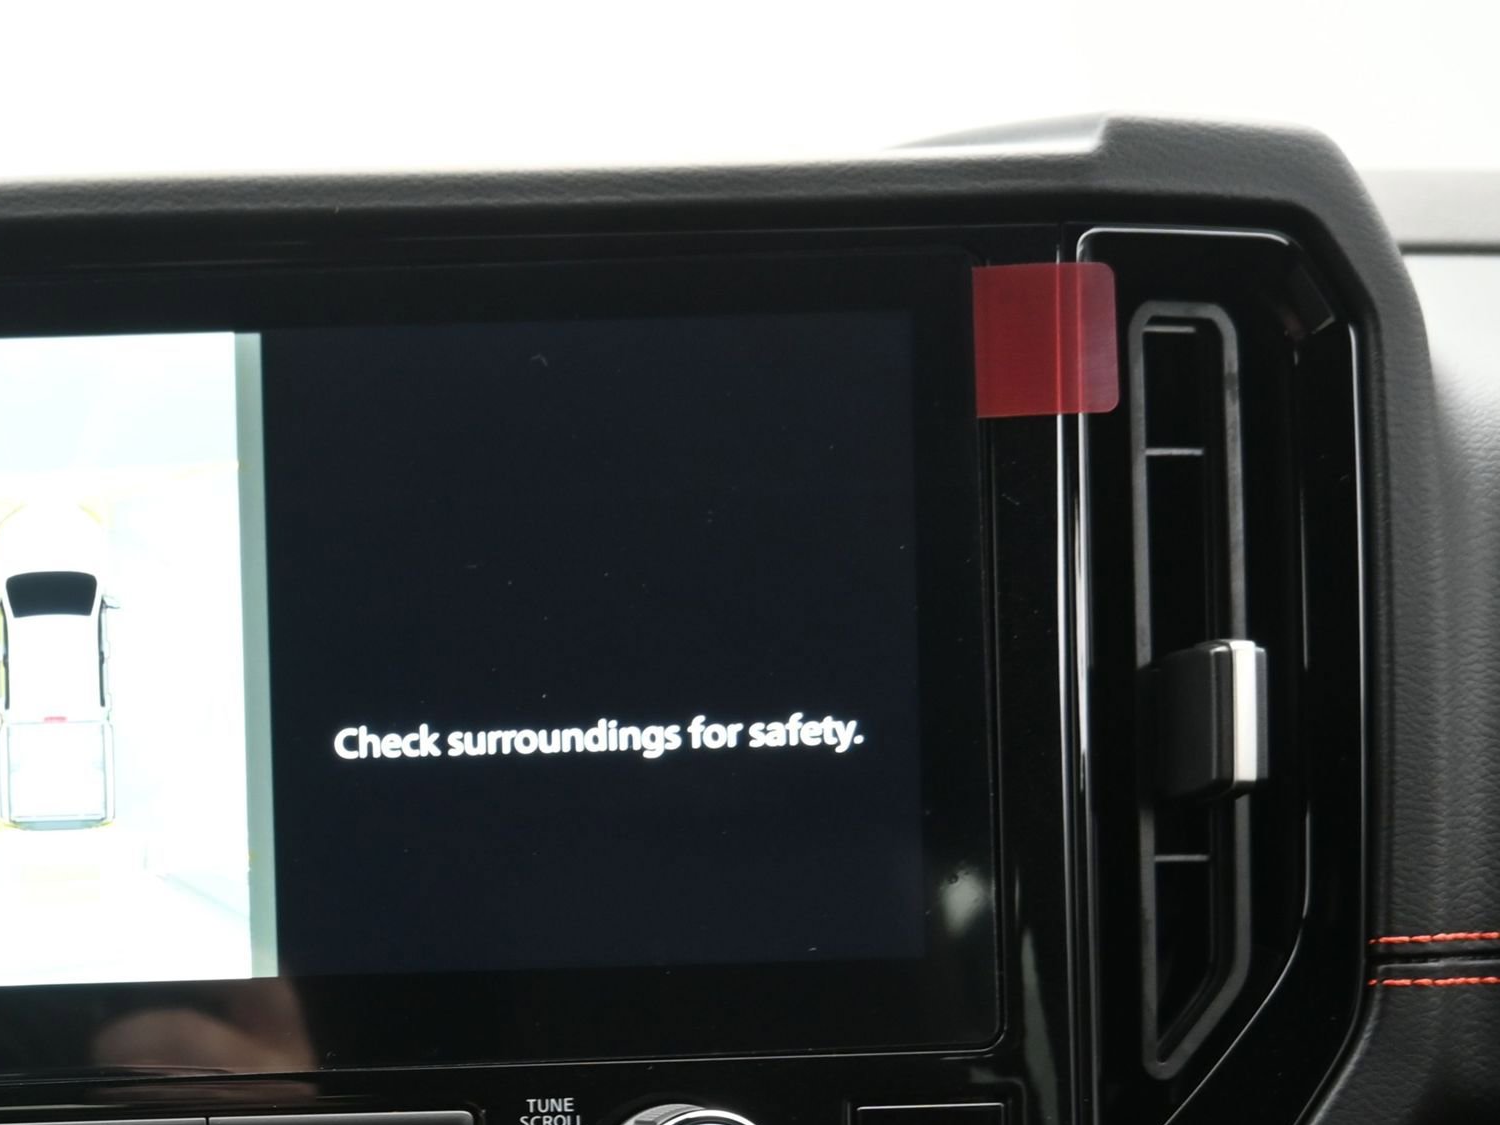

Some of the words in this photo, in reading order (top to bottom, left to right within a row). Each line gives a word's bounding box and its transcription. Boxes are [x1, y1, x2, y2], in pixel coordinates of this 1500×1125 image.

[333, 722, 442, 760] Check
[446, 717, 683, 759] surroundings
[686, 714, 745, 750] for
[748, 711, 865, 754] safety.
[525, 1097, 575, 1114] TUNE
